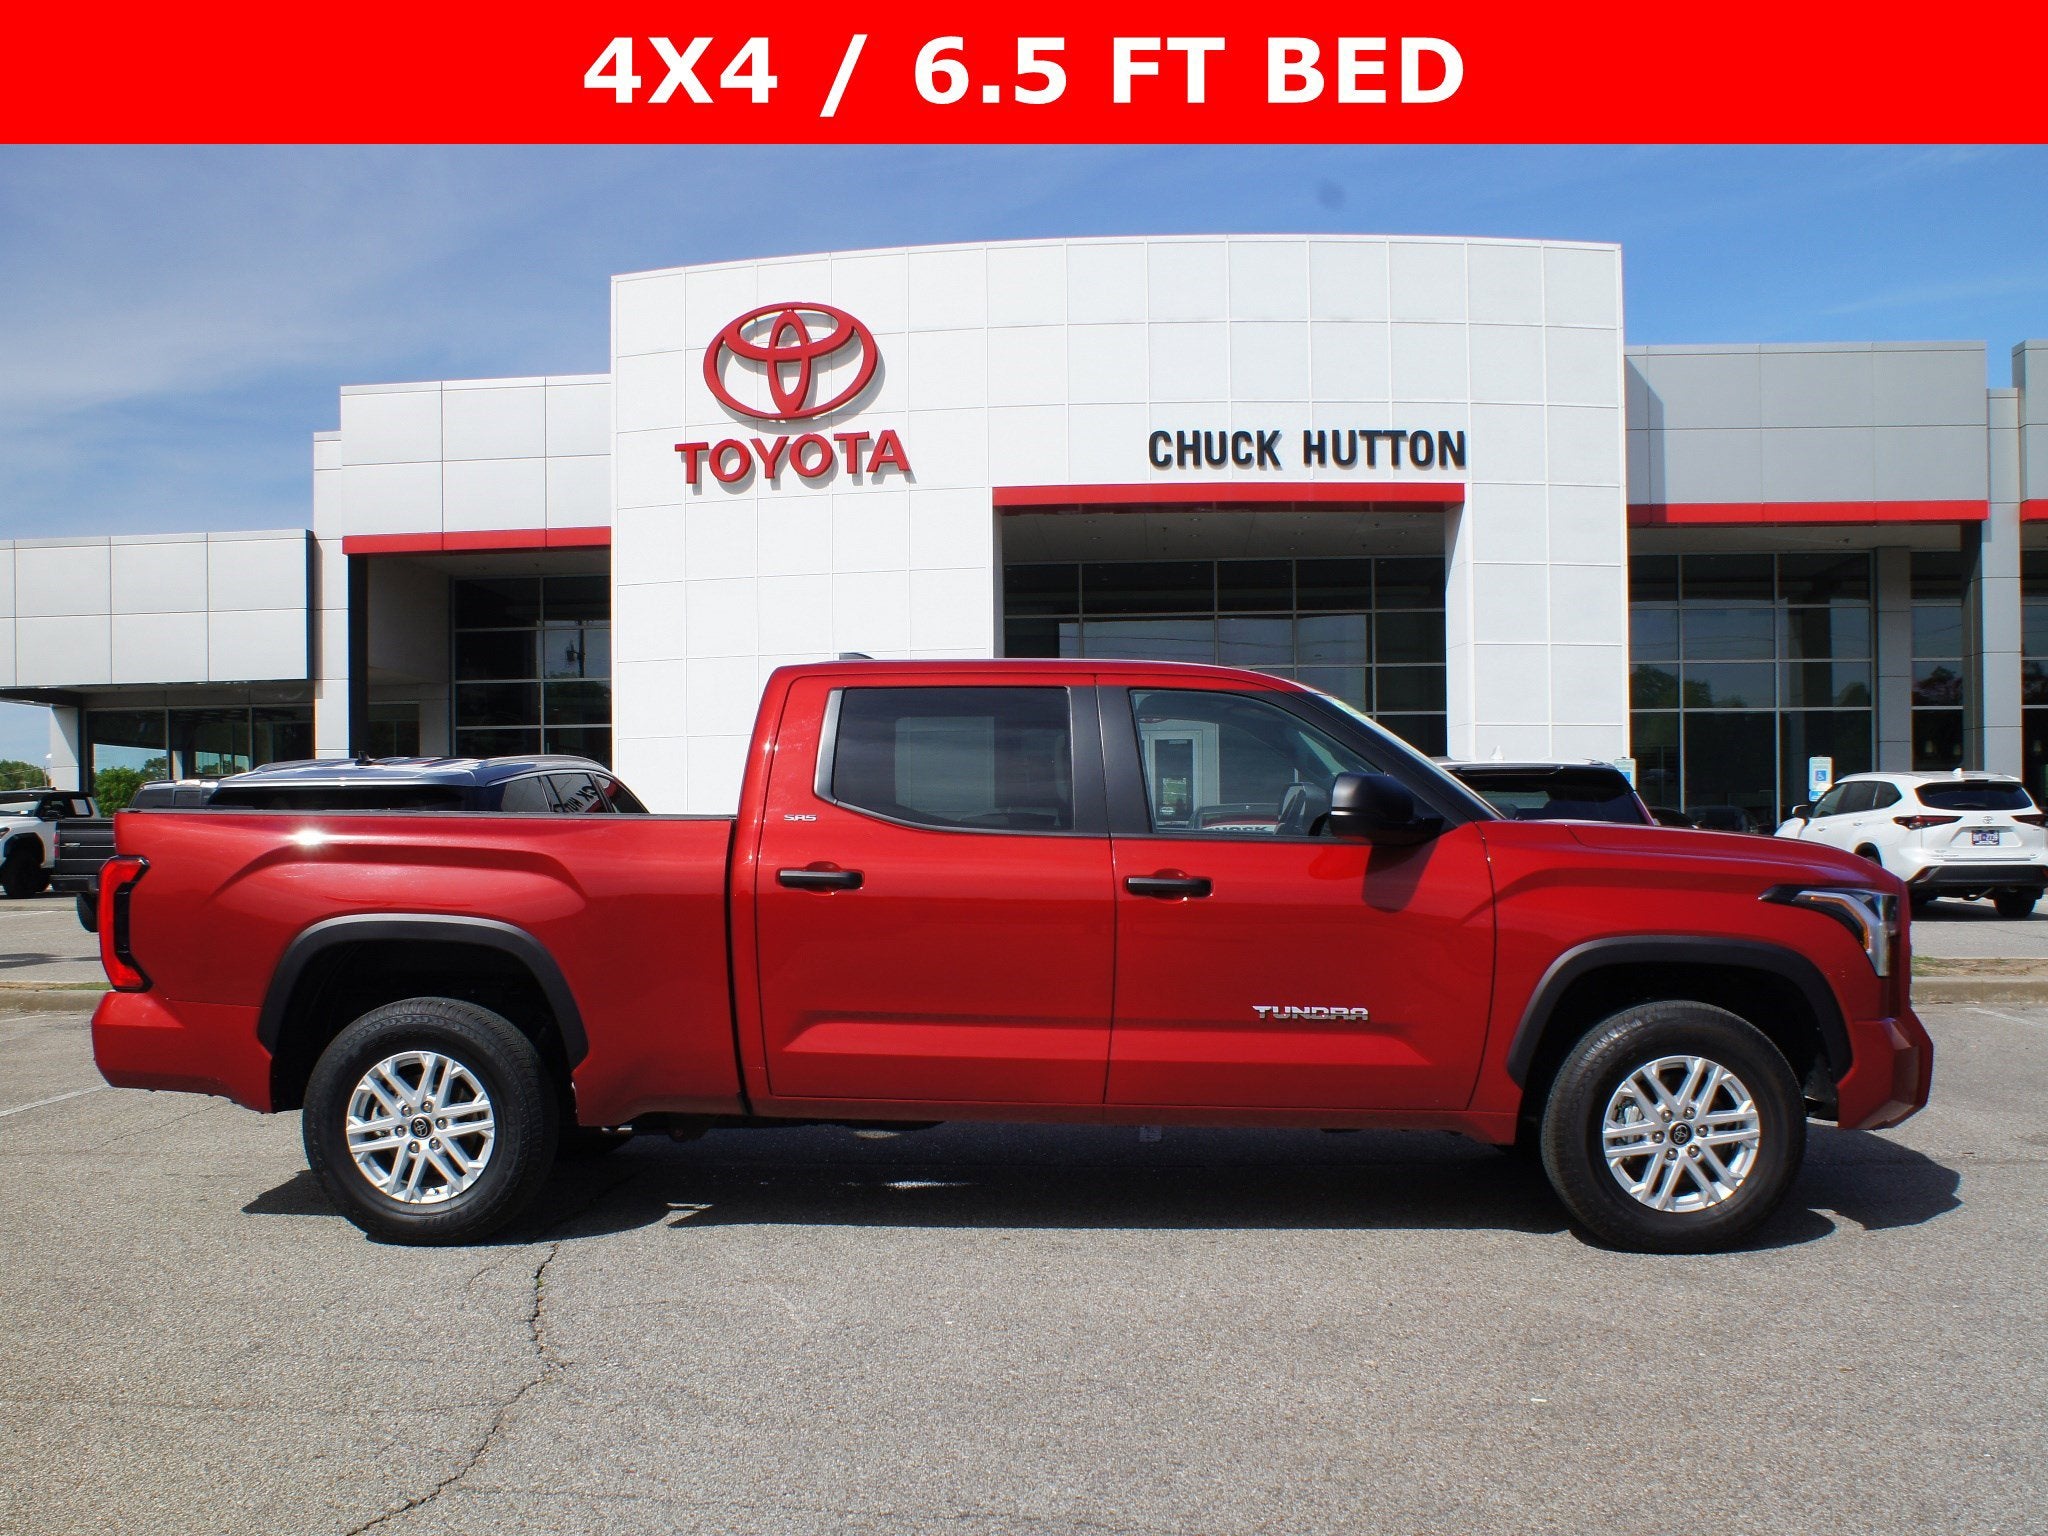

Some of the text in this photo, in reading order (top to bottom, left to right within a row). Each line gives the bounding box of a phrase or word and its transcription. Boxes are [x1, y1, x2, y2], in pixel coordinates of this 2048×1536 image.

[674, 429, 910, 484] TOYOTA
[1148, 429, 1466, 467] CHUCK HUTTON
[1252, 1005, 1369, 1020] TUNDRA
